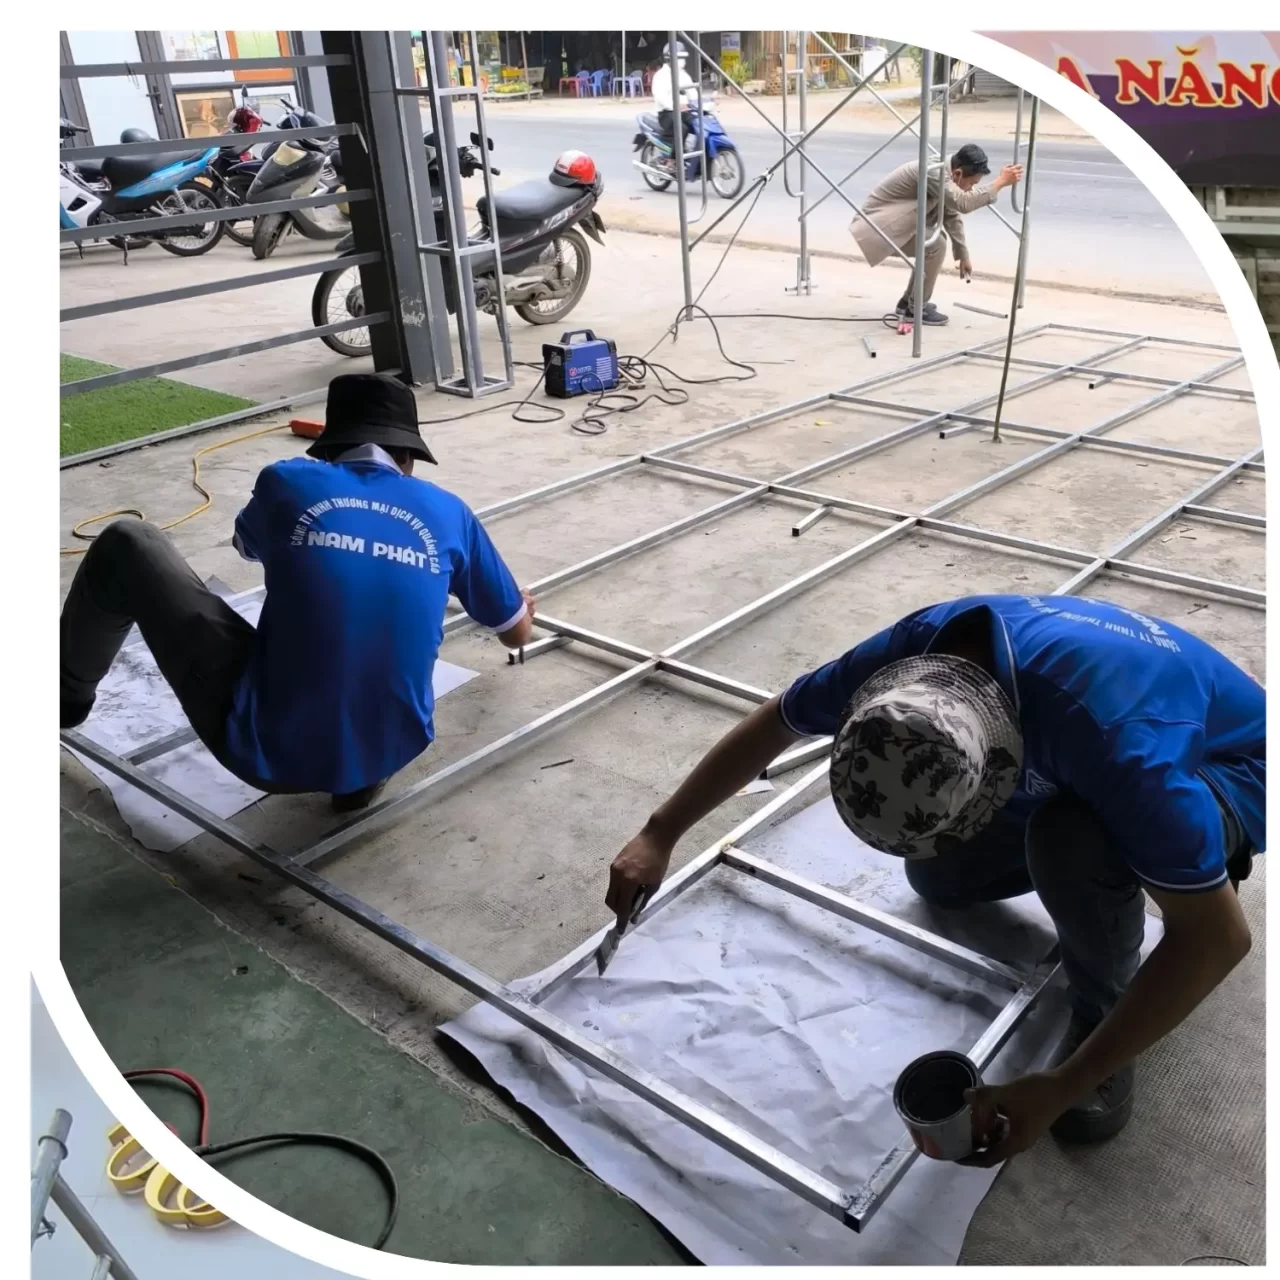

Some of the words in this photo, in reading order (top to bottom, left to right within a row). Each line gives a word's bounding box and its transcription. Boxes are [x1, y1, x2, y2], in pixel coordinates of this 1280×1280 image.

[299, 514, 313, 525] TY
[307, 500, 333, 517] TNHH
[331, 497, 369, 510] THƯƠNG
[371, 501, 389, 514] MẠI
[390, 506, 413, 523] DỊCH
[307, 531, 365, 553] NAM
[372, 542, 427, 569] PHÁT
